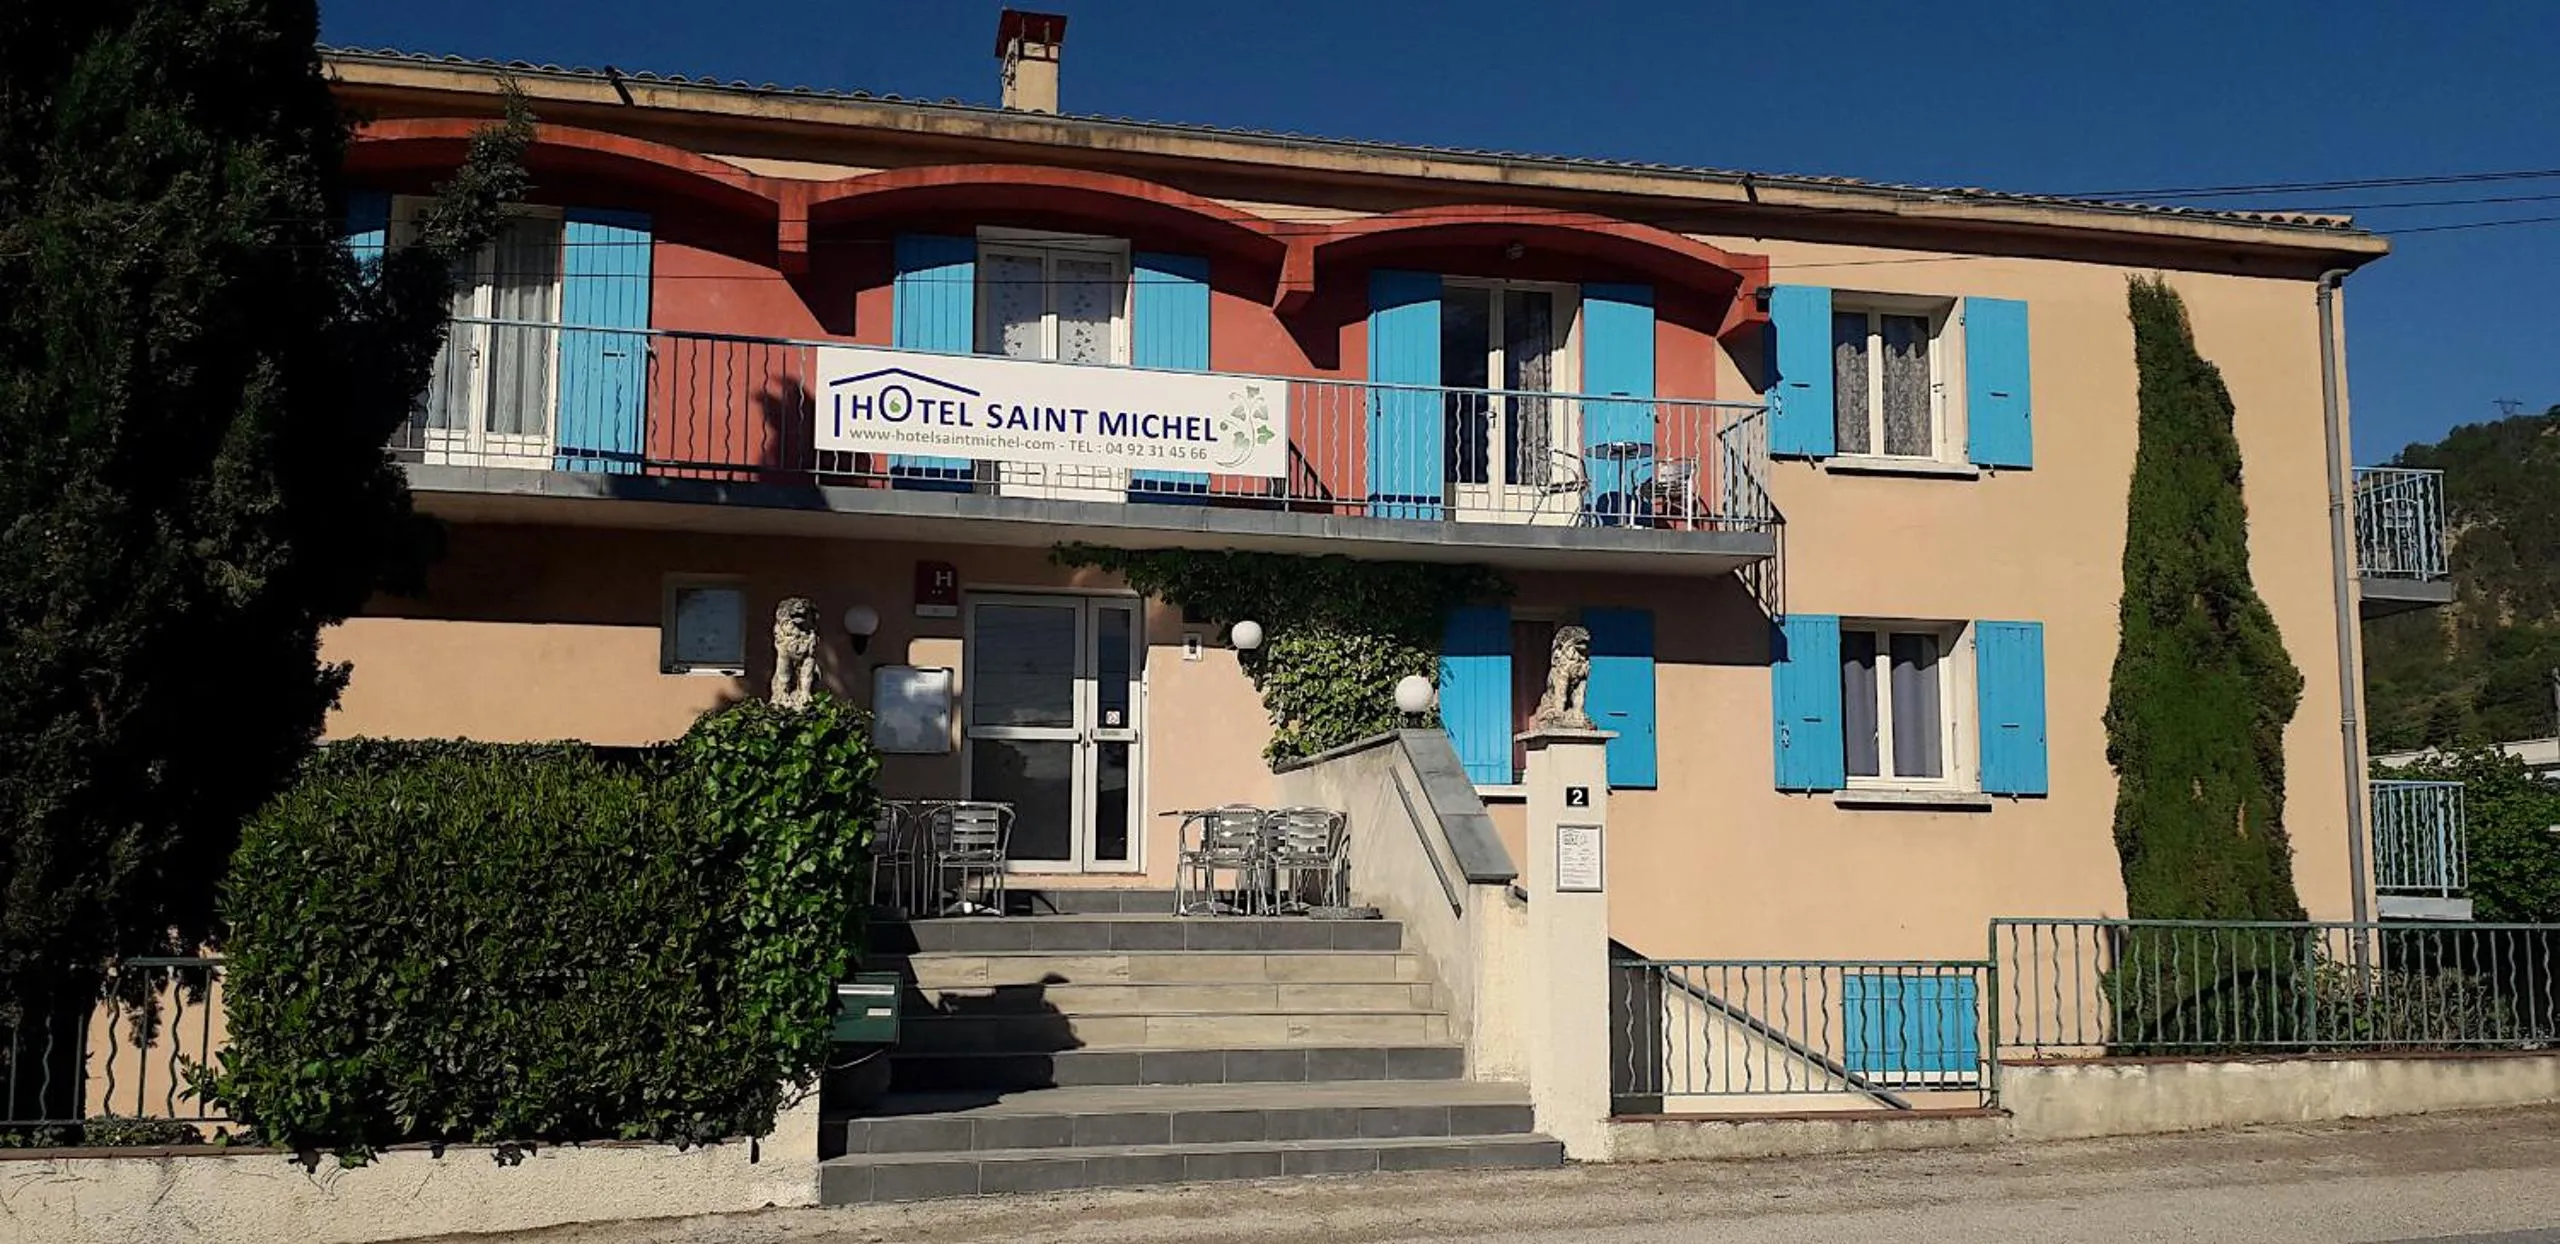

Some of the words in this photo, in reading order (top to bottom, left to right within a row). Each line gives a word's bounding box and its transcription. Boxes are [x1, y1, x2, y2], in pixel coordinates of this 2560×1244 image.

[851, 384, 974, 428] HOTEL
[986, 403, 1089, 434] SAINT
[1098, 410, 1219, 442] MICHEL
[1069, 440, 1093, 453] TEL
[1105, 442, 1123, 455] 04
[1127, 443, 1145, 456] 92
[1148, 445, 1164, 457] 31
[1169, 446, 1186, 459] 45
[1190, 447, 1208, 460] 66
[935, 570, 952, 588] H
[1571, 789, 1584, 805] 2
